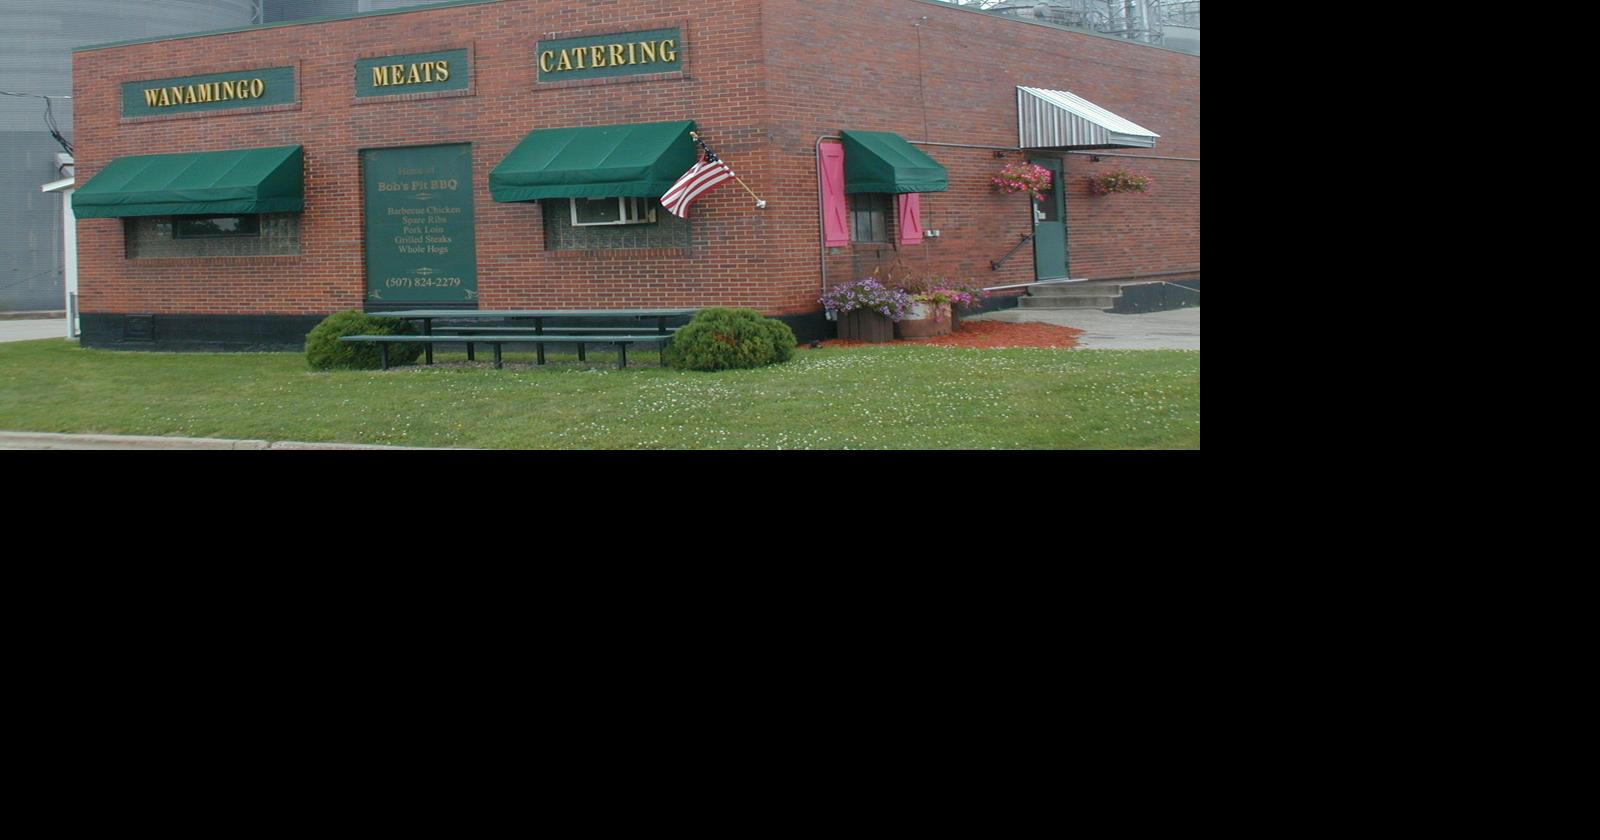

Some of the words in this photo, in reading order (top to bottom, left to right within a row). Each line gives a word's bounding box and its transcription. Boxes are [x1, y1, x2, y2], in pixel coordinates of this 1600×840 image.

[539, 39, 677, 73] CATERING
[372, 60, 449, 87] MEATS
[144, 78, 265, 107] WANAMINGO
[378, 182, 409, 191] Bob's
[411, 181, 428, 190] Pit
[430, 179, 458, 190] BBQ
[387, 207, 425, 215] Barbecue
[426, 206, 461, 214] Chicken
[402, 217, 425, 225] Spare
[428, 216, 447, 224] Ribs
[403, 226, 422, 234] Pork
[394, 236, 423, 244] Grilled
[425, 235, 452, 243] Steaks
[398, 245, 425, 253] Whole
[427, 245, 448, 254] Hogs
[385, 277, 412, 288] (507)
[414, 277, 461, 287] 824-2279
